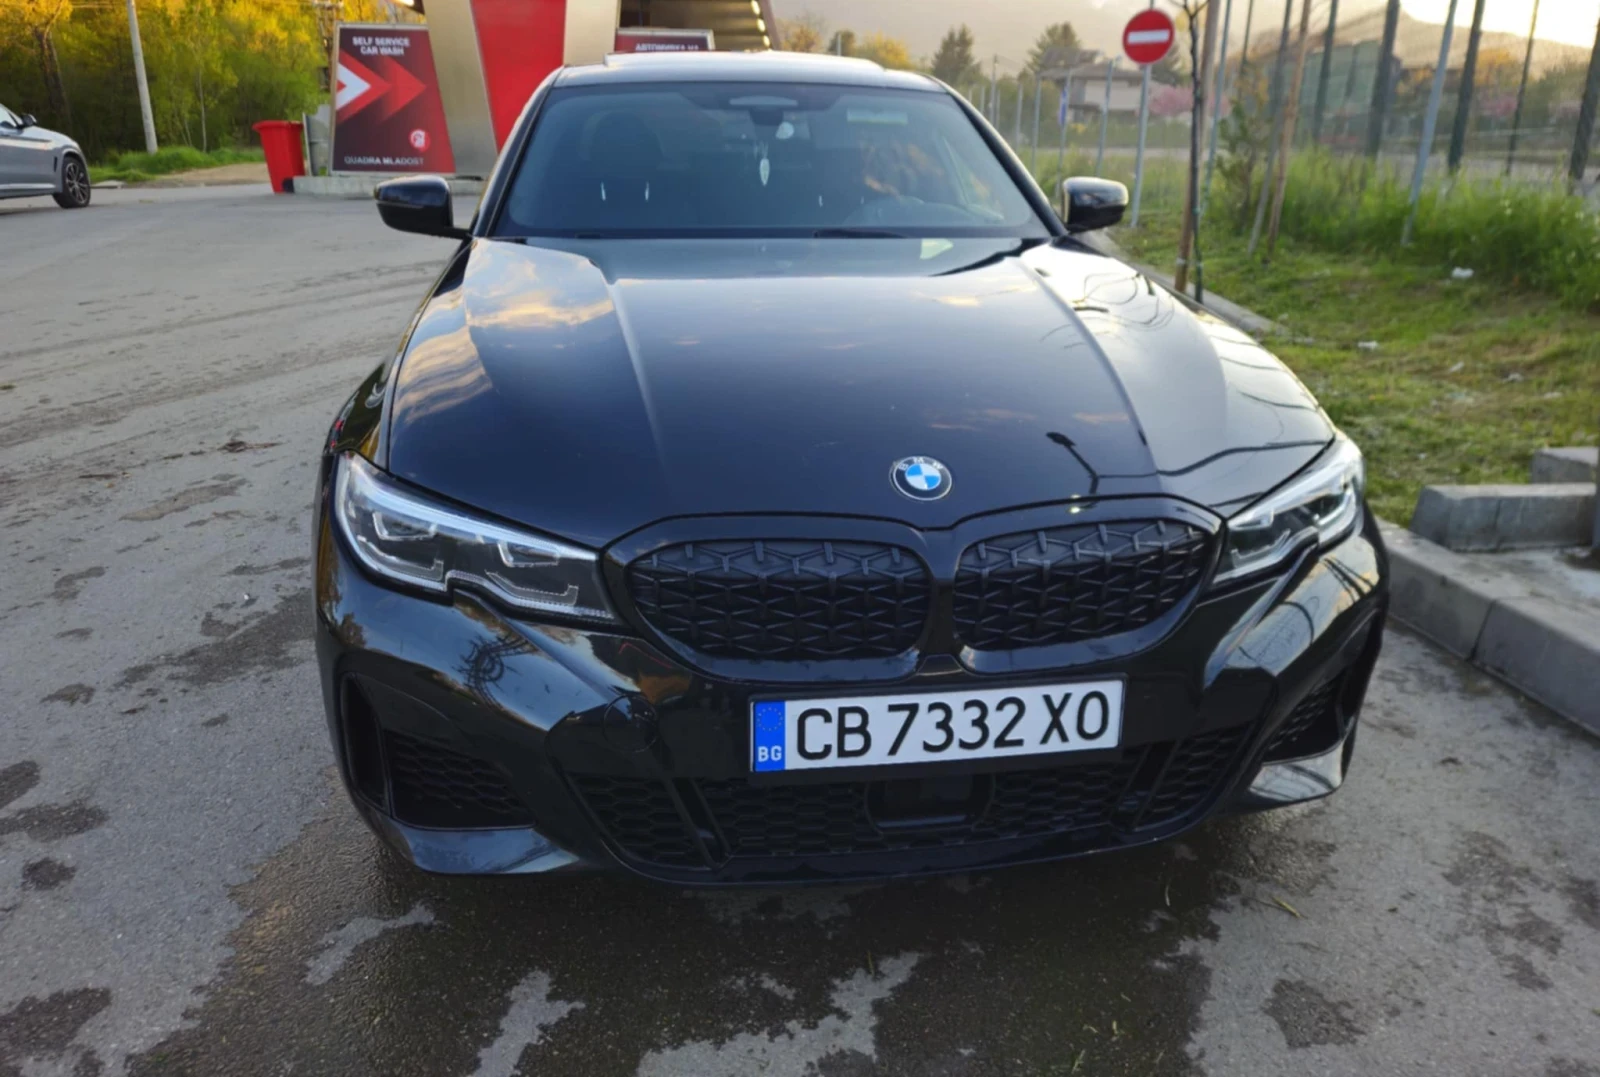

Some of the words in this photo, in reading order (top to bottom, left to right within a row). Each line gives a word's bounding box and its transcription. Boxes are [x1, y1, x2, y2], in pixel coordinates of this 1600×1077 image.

[352, 36, 373, 46] SELF
[375, 37, 410, 47] SERVICE
[360, 46, 378, 55] CAR
[379, 47, 405, 56] WASH
[344, 156, 382, 165] QUADRA
[382, 156, 425, 166] MLADOST
[796, 706, 872, 761] CB
[887, 696, 1027, 756] 7332
[1039, 690, 1110, 745] XO
[757, 745, 783, 763] BG
